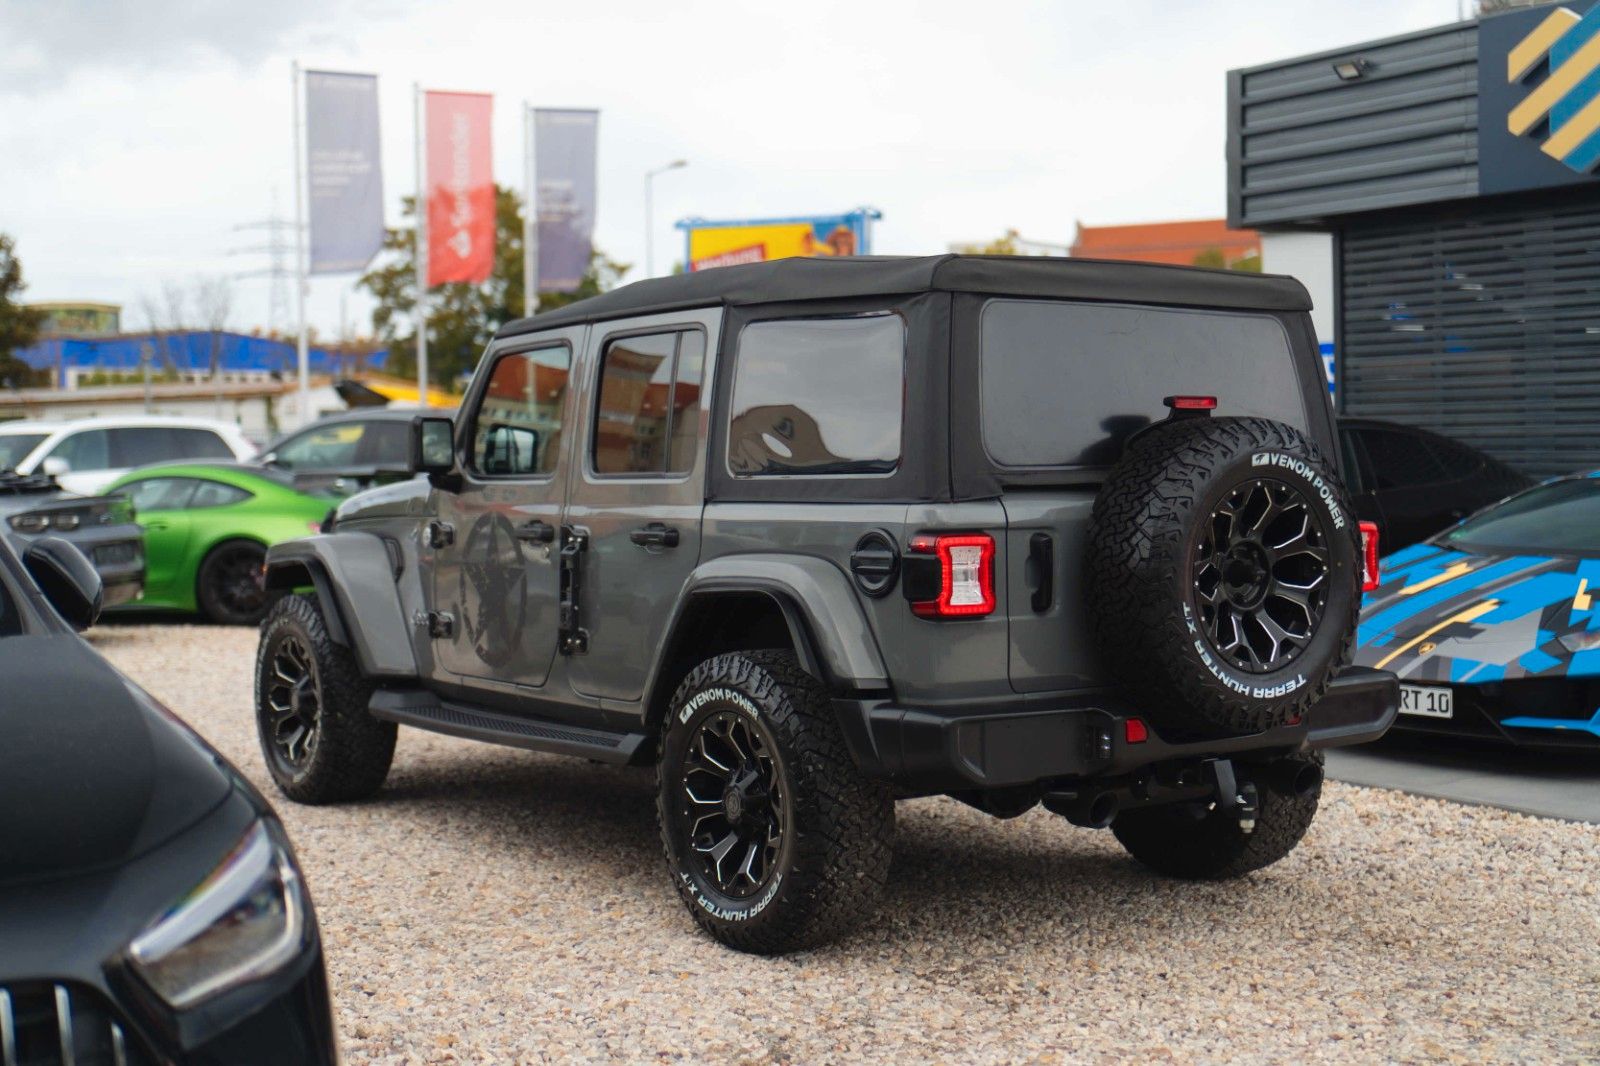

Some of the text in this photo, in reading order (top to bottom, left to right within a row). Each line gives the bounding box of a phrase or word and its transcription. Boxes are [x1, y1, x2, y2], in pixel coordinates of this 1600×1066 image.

[1270, 453, 1345, 530] VENOM POWER
[1194, 639, 1250, 696] HUNTER
[1253, 674, 1307, 699] TERRA
[1427, 692, 1450, 713] 10
[689, 688, 759, 721] VENOM POWER
[697, 895, 748, 921] HUNTER
[750, 872, 783, 918] TERRA
